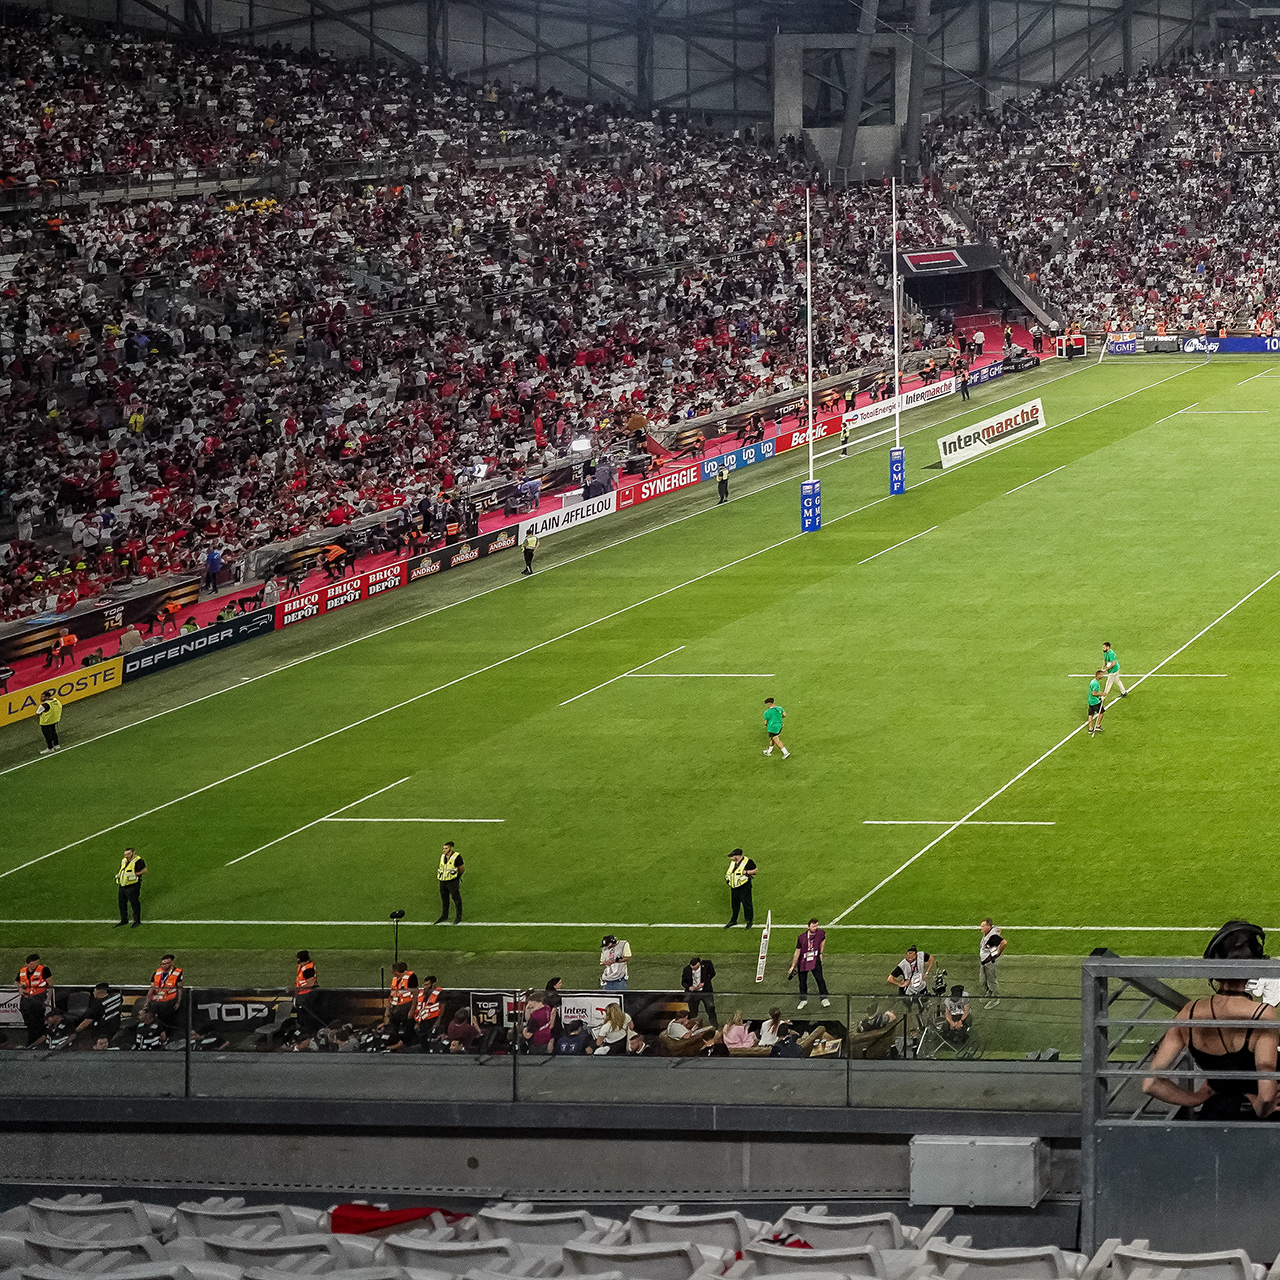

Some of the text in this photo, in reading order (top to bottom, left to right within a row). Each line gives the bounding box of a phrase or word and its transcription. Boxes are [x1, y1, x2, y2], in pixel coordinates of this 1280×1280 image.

[1116, 344, 1135, 352] GMF
[989, 364, 1004, 377] GMF
[906, 381, 953, 406] Intermarché
[791, 424, 828, 447] Betclic
[942, 404, 1040, 456] Intermarché
[641, 468, 698, 499] SYNERGIE
[892, 463, 902, 491] GMF
[527, 497, 612, 536] ALAIN AFFLELOU
[803, 498, 813, 528] GMF
[488, 536, 516, 553] ANDROS
[451, 548, 480, 565] ANDROS
[368, 565, 401, 584] BRICO
[411, 560, 441, 578] ANDROS
[327, 579, 361, 598] BRICO
[368, 575, 401, 596] DEPÔT
[284, 593, 319, 613] BRICO
[326, 590, 361, 610] DEPÔT
[103, 605, 125, 618] TOP
[283, 604, 319, 626] DEPÔT
[126, 628, 234, 674] DEFENDER
[8, 667, 116, 716] LA POSTE
[476, 1001, 498, 1010] TOP
[564, 1006, 588, 1017] Inter
